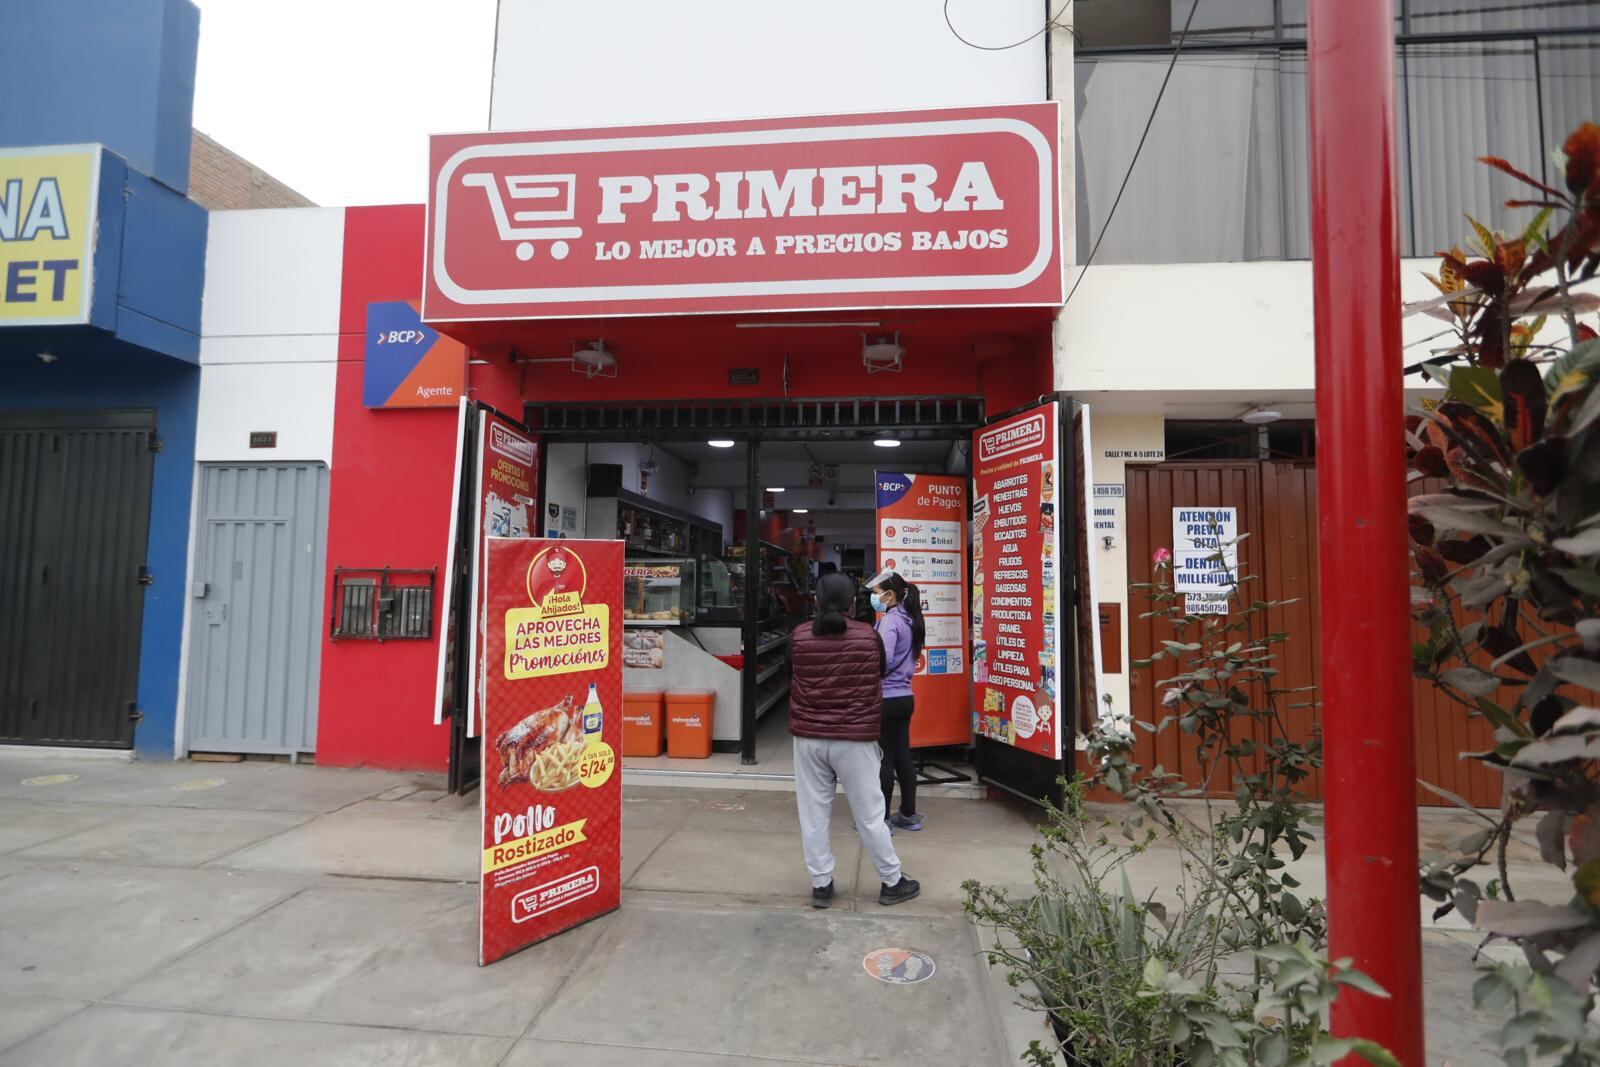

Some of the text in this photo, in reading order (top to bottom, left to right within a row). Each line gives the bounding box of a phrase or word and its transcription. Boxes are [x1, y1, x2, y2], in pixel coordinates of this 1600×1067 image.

[597, 161, 1004, 224] PRIMERA
[595, 229, 1009, 261] LO MEJOR A PRECIOS BAJOS
[388, 330, 416, 343] BCP
[416, 386, 453, 398] Agente
[996, 420, 1041, 445] PRIMERA
[1105, 450, 1120, 458] CALLE
[1144, 450, 1156, 458] LOTE
[497, 459, 521, 478] OFERTAS
[491, 468, 529, 492] PROMOCIONES
[993, 474, 1028, 490] ABARROTES
[883, 483, 901, 492] BCP
[928, 484, 961, 496] PUNTO
[993, 487, 1028, 503] MENESTRAS
[917, 496, 961, 509] de Pagos
[998, 502, 1022, 515] HUEVOS
[1094, 508, 1115, 516] IMBRE
[993, 515, 1027, 529] EMBUTIDOS
[1094, 521, 1115, 529] ENTAL
[902, 525, 921, 533] Claro
[994, 528, 1027, 542] BOCADITOS
[1002, 543, 1018, 553] AGUA
[998, 556, 1022, 567] FRUGOS
[993, 569, 1028, 580] REFRESCOS
[995, 583, 1027, 593] GASEOSAS
[548, 594, 571, 604] ¡Hola
[991, 597, 1032, 607] CONDIMENTOS
[541, 602, 580, 615] Ahijados!
[991, 609, 1032, 621] PRODUCTOS A
[516, 617, 601, 636] APROVECHA
[998, 623, 1022, 634] GRANEL
[515, 632, 601, 651] LAS MEJORES
[996, 634, 1026, 648] ÚTILES DE
[951, 657, 962, 666] 75
[997, 650, 1025, 662] LIMPIEZA
[930, 659, 947, 667] SOAT
[992, 659, 1031, 677] ÚTILES PARA
[988, 675, 1036, 692] ASEO PERSONAL
[587, 751, 598, 760] TAN
[598, 749, 611, 758] SOLO
[494, 804, 556, 845] Pollo
[493, 828, 575, 865] Rostizado
[539, 873, 594, 901] PRIMERA
